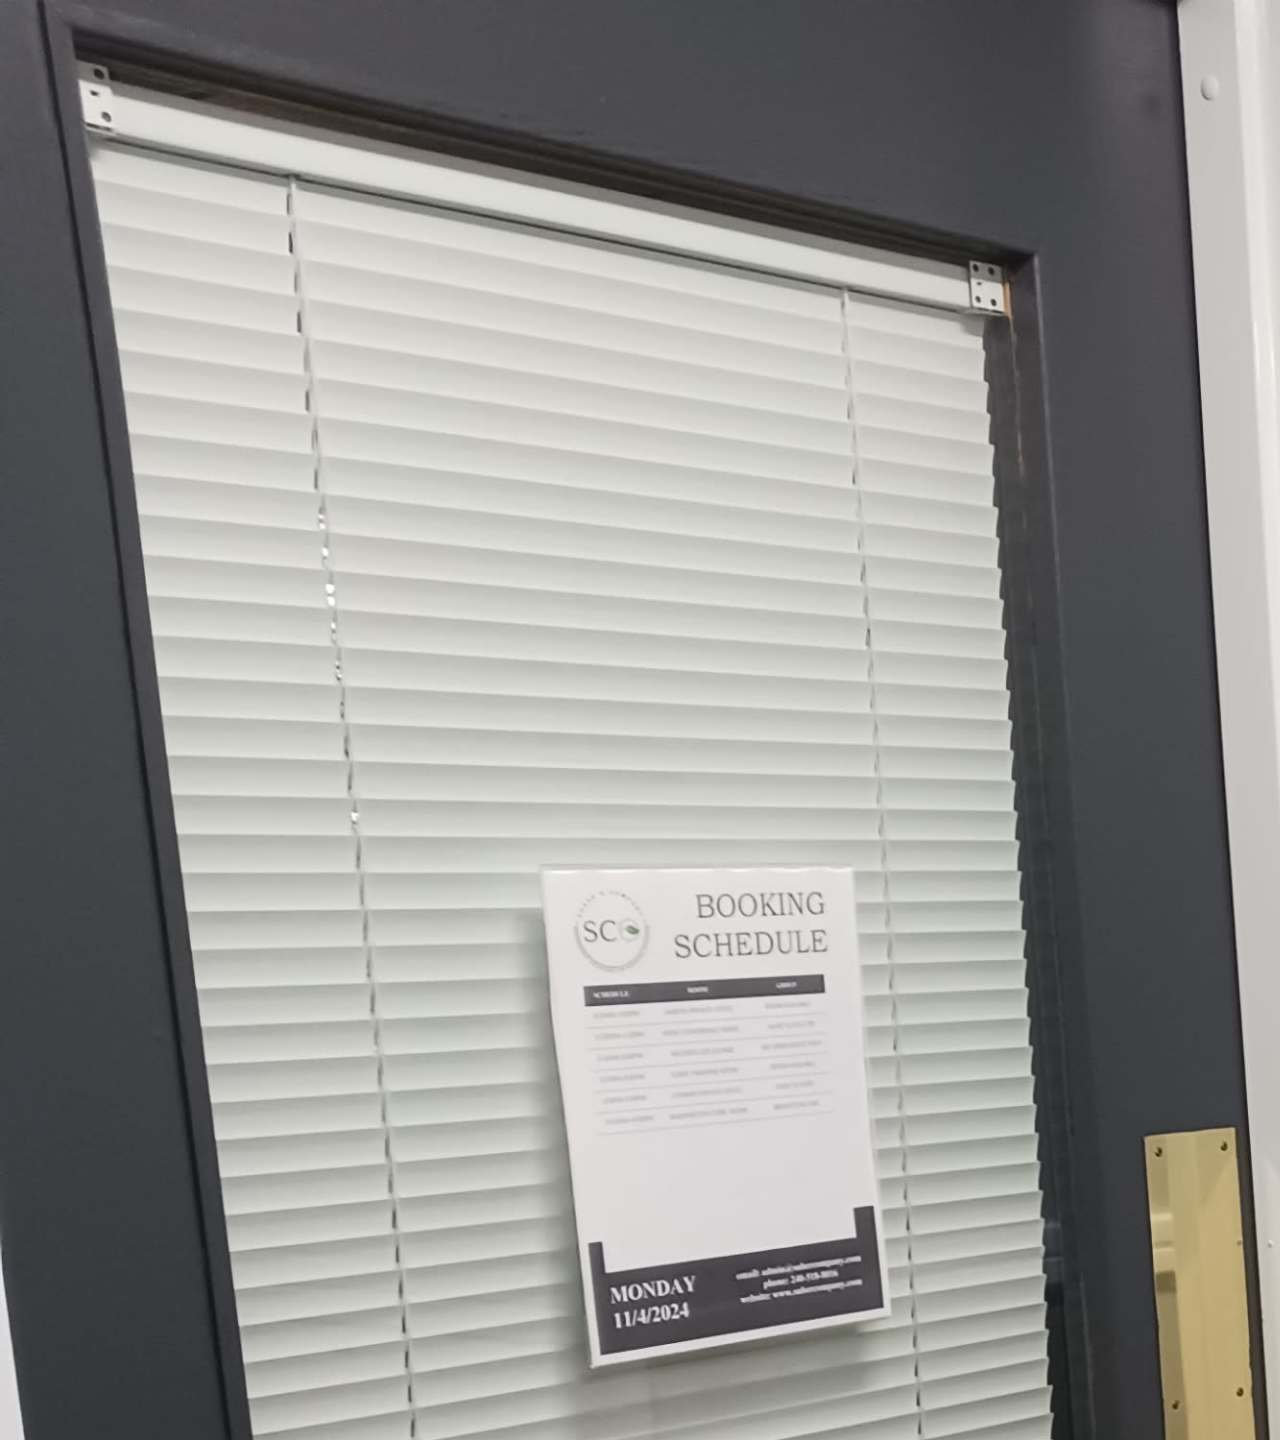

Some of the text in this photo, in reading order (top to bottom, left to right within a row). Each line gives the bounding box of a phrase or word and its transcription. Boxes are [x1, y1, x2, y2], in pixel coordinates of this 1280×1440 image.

[695, 890, 826, 919] BOOKING
[673, 929, 829, 959] SCHEDULE
[610, 1275, 697, 1304] MONDAY
[613, 1301, 691, 1329] 11/4/2024
